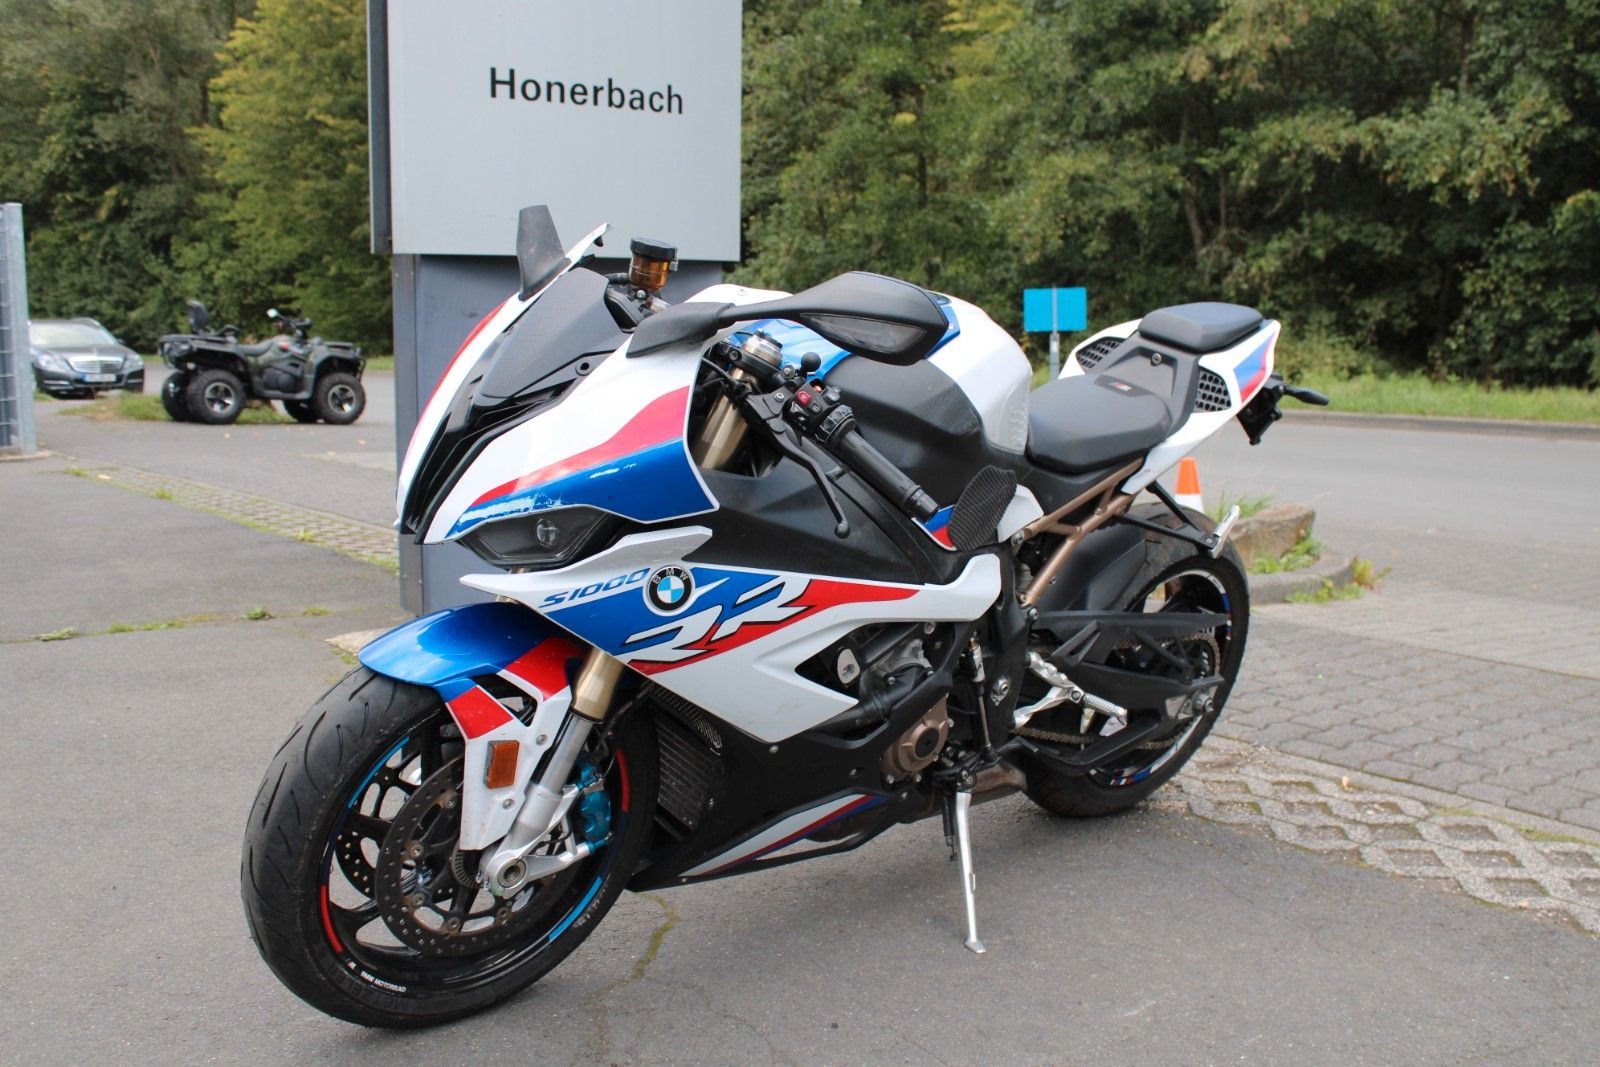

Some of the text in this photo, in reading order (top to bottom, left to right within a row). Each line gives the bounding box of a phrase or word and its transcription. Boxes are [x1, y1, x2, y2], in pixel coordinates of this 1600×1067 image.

[490, 67, 683, 114] Honerbach
[538, 567, 651, 608] S1000
[652, 567, 690, 584] BMW
[374, 978, 407, 993] MOTORRAD
